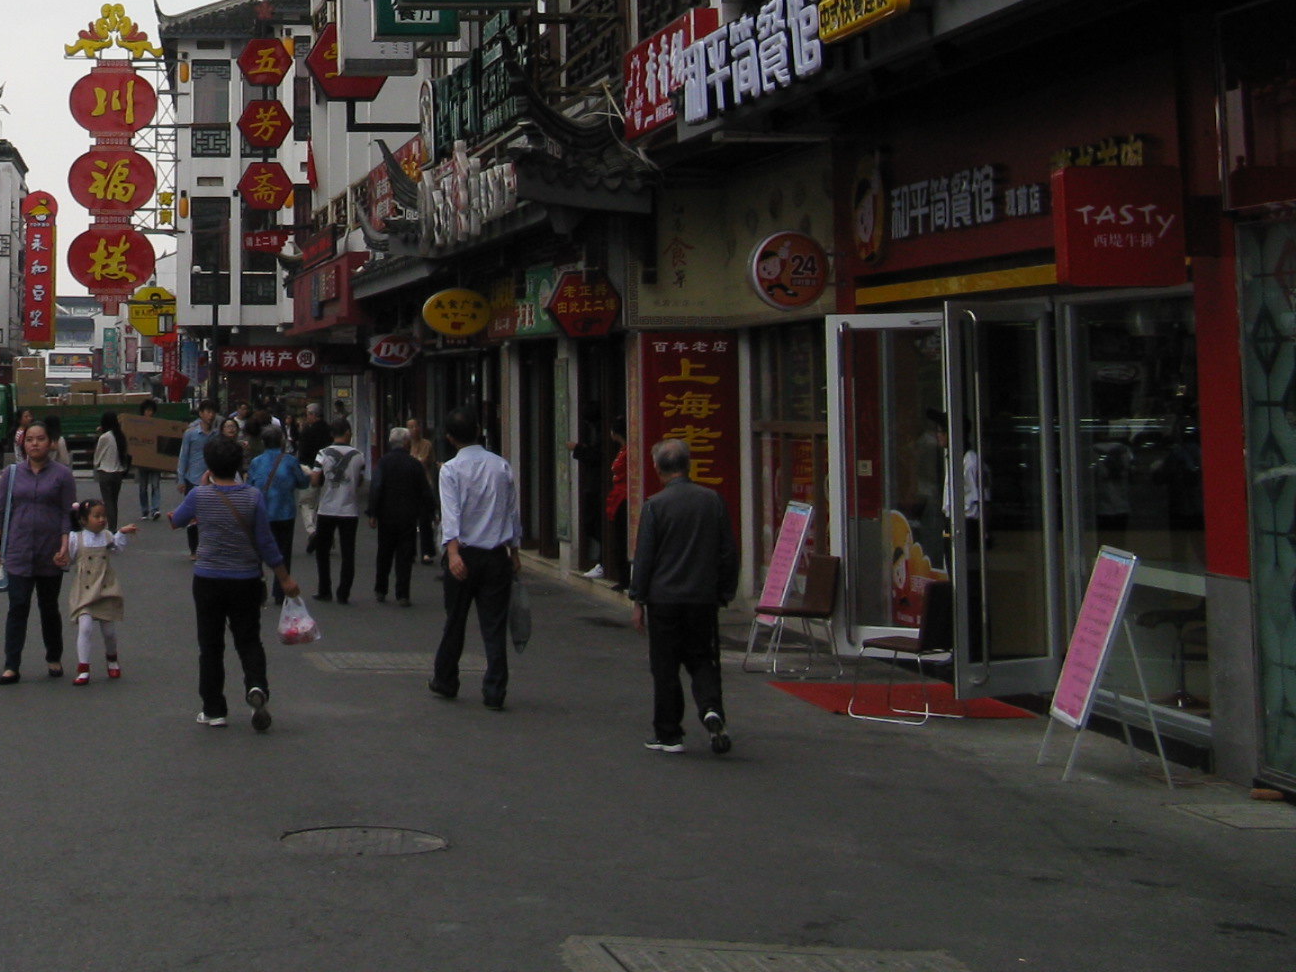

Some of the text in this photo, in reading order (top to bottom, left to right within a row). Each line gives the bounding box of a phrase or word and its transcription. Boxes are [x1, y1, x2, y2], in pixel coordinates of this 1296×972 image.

[791, 254, 818, 276] 24
[652, 341, 729, 353] 百年老店
[222, 350, 294, 369] 苏州特产
